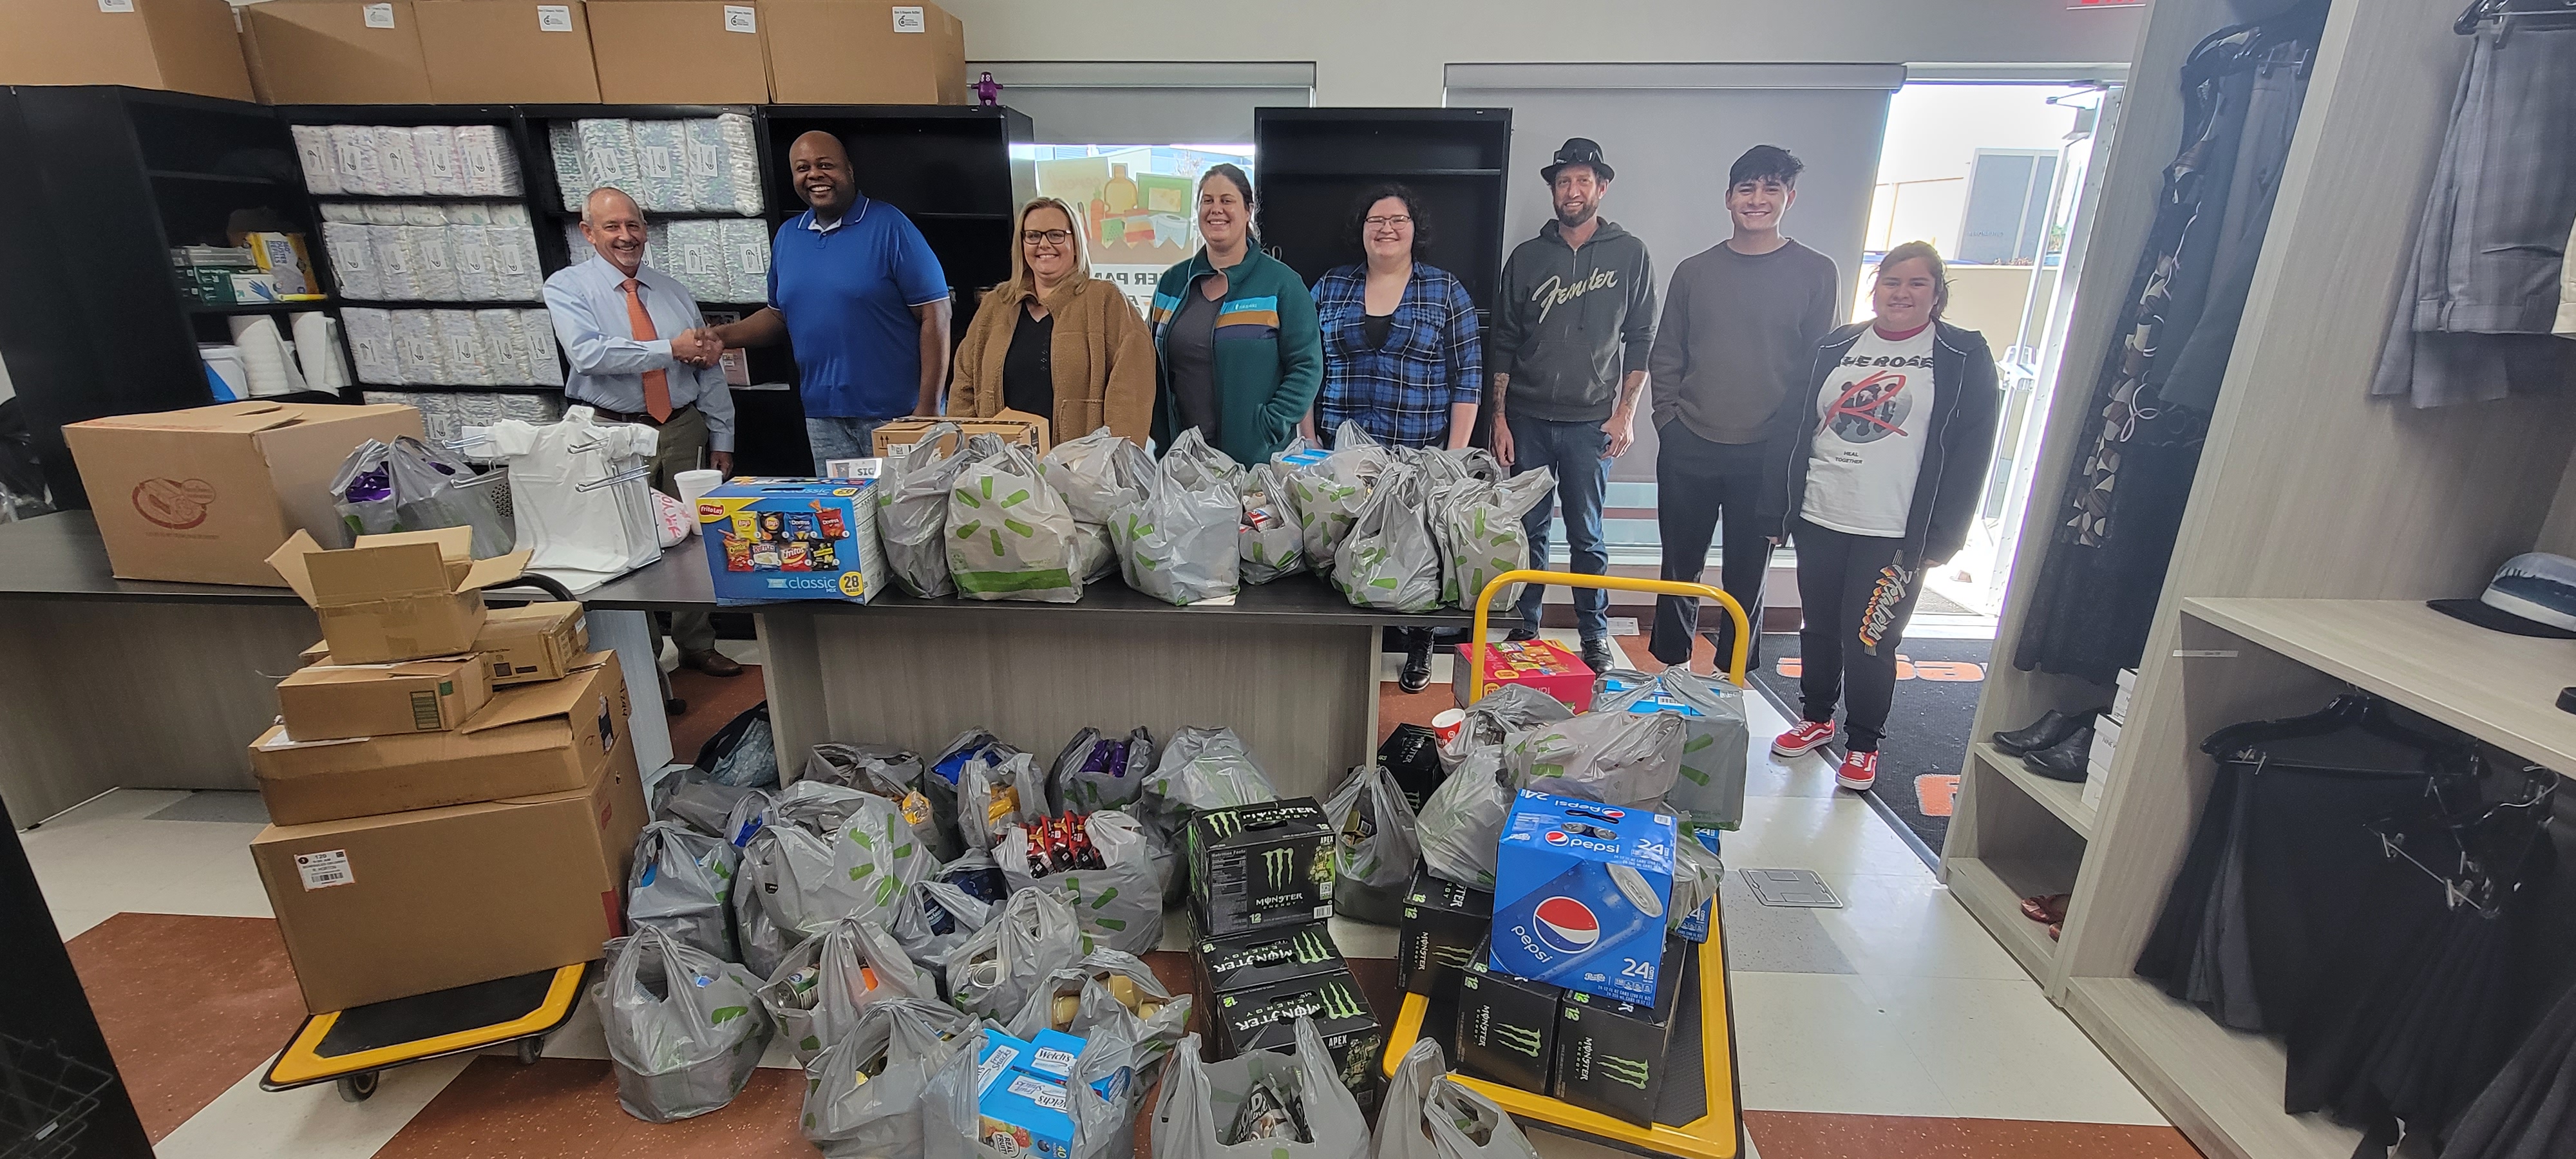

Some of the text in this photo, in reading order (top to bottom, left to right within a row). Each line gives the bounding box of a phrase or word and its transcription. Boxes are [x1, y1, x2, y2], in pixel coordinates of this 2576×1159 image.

[1531, 267, 1618, 324] Fender
[1873, 355, 1934, 368] ROSE
[789, 576, 837, 589] classic
[844, 576, 859, 589] 28
[1525, 789, 1550, 801] 24
[1555, 800, 1601, 813] pepsi
[1320, 836, 1334, 845] APEX
[1570, 838, 1620, 853] pepsi
[1637, 838, 1664, 855] 24
[1256, 892, 1303, 906] MONSTER
[1263, 901, 1297, 910] ENERGY
[1412, 894, 1426, 903] 12
[1249, 913, 1262, 924] 12
[1405, 907, 1417, 919] 12
[1203, 942, 1217, 954] 12
[1418, 932, 1429, 970] MONSTER
[1511, 925, 1555, 965] pepsi
[1224, 945, 1279, 961] ENERGY
[1213, 948, 1293, 973] MONSTER
[1473, 962, 1488, 974] 12
[1622, 957, 1650, 979] 24
[1464, 975, 1479, 990] 12
[1223, 996, 1238, 1008] 12
[1573, 992, 1591, 1004] 12
[1245, 999, 1305, 1018] ENERGY
[1565, 1007, 1580, 1022] 12
[1235, 1003, 1321, 1031] MONSTER
[1478, 1004, 1491, 1047] MONSTER
[1329, 1035, 1347, 1048] APEX
[1039, 1050, 1072, 1062] Welch's
[1580, 1037, 1594, 1081] MONSTER
[1003, 1136, 1012, 1154] REAL
[1057, 1145, 1067, 1159] 40
